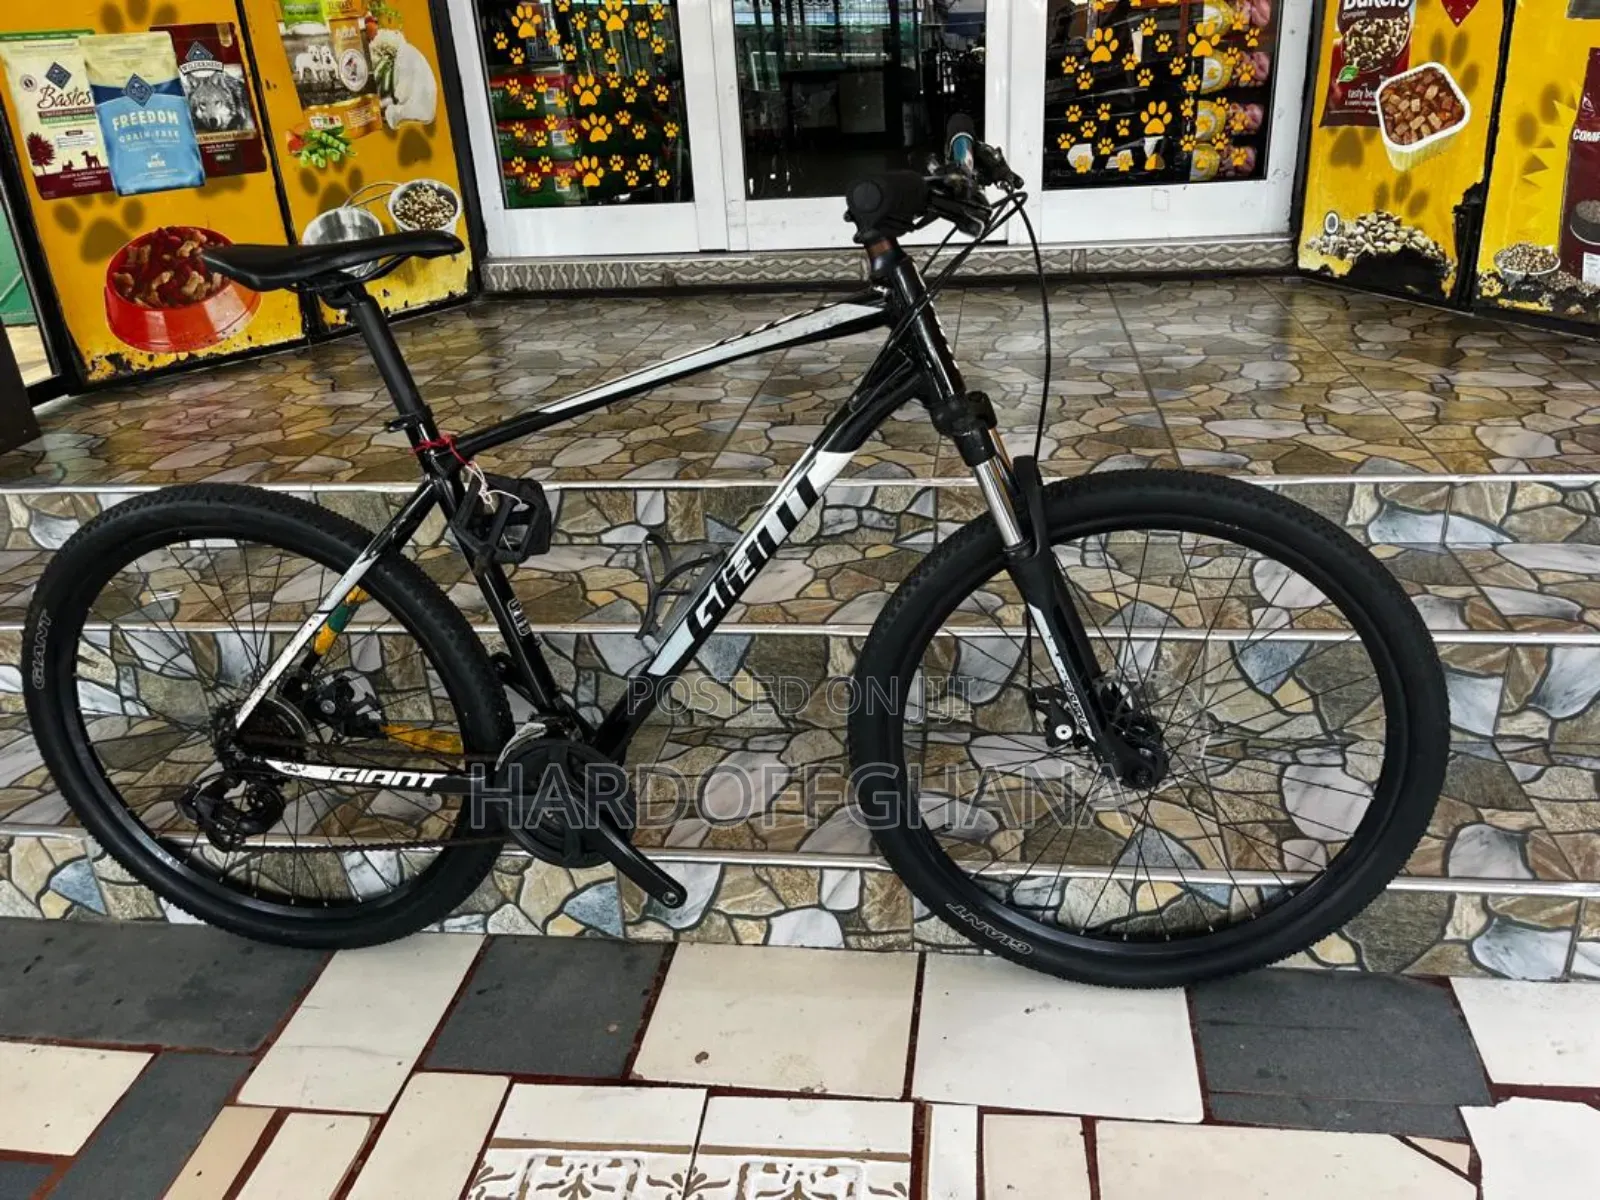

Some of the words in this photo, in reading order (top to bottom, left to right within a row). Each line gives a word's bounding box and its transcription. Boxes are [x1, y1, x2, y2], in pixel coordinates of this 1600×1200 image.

[37, 84, 92, 109] Basics
[112, 109, 180, 131] FREEDOM
[32, 607, 52, 690] GIANT
[330, 766, 448, 788] GIANT
[945, 902, 1034, 955] GIANT
